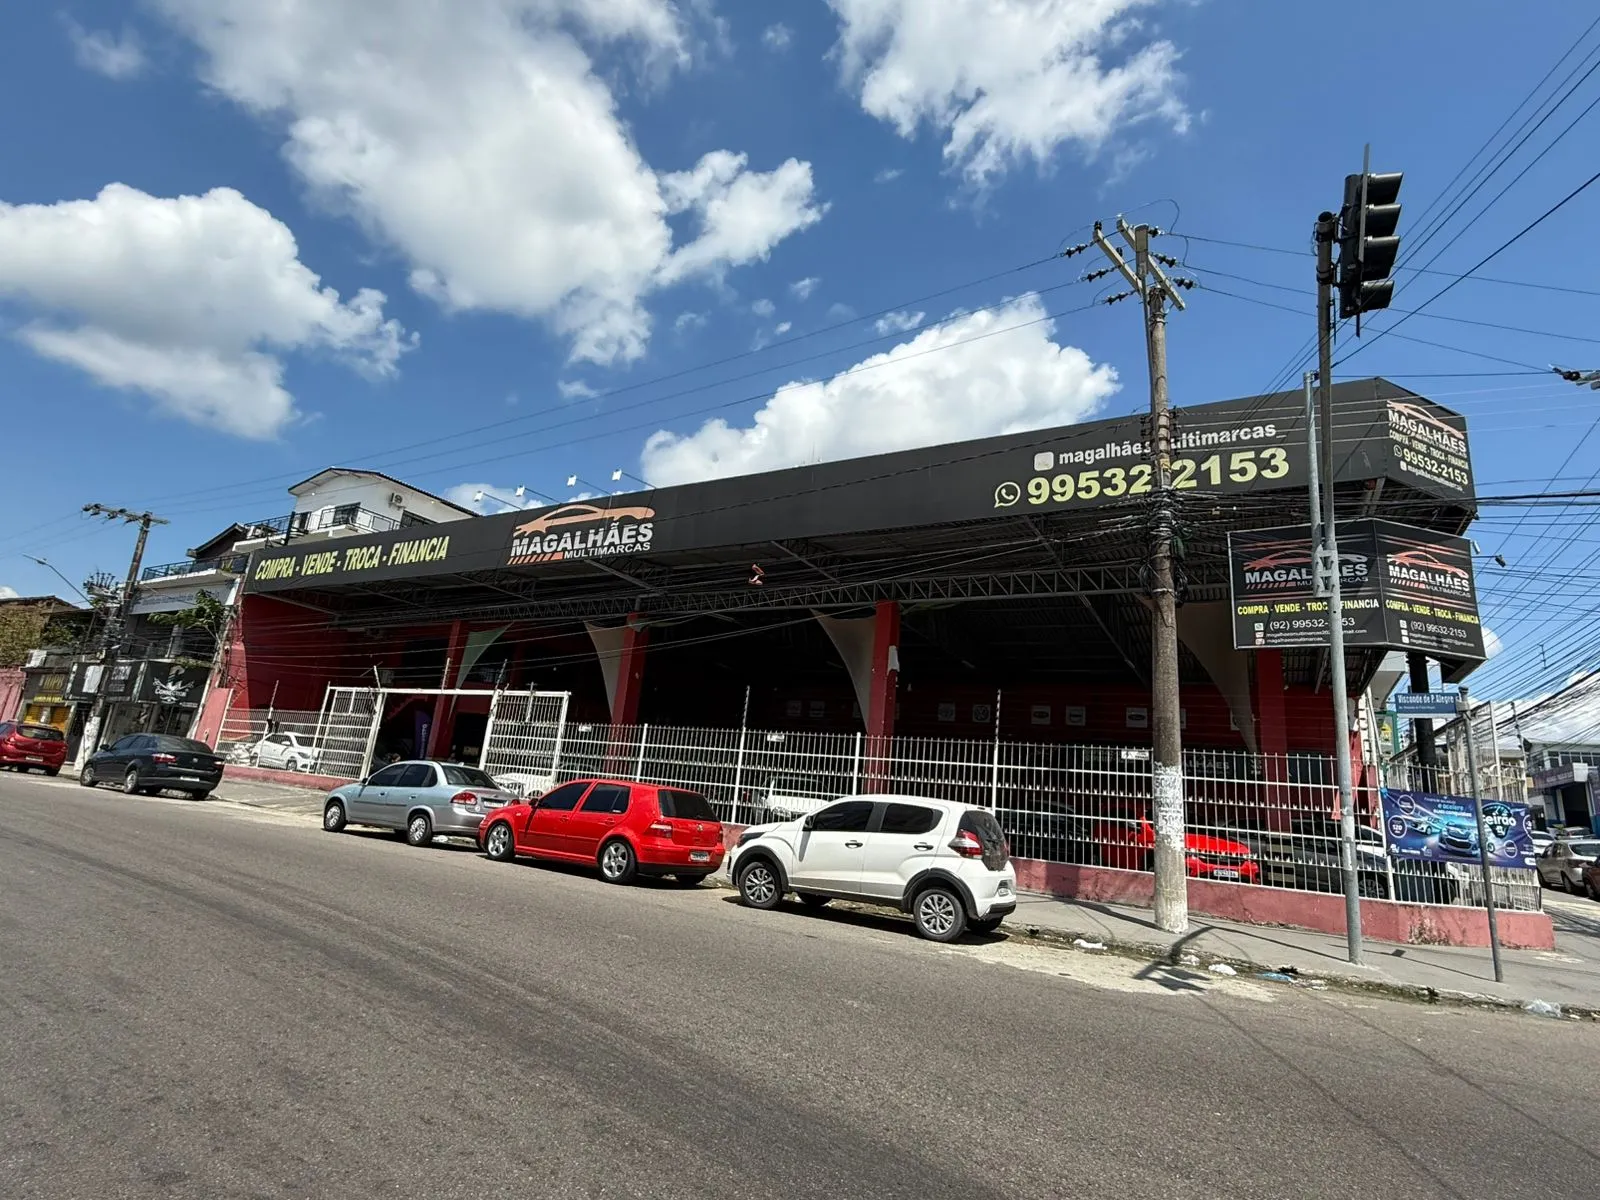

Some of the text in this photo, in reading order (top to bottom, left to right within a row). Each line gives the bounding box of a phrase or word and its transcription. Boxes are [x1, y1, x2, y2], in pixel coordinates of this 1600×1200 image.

[1059, 423, 1287, 465] magalhãesultimarcas_
[1389, 429, 1409, 445] COMPRA
[1412, 439, 1427, 454] VENDE
[1430, 447, 1446, 460] TROCA
[1447, 454, 1469, 471] FINANCIA
[1028, 447, 1290, 505] 995322153
[1403, 448, 1469, 485] 99532-2153
[510, 522, 653, 557] MAGALHÃES
[563, 541, 651, 560] MULTIMARCAS
[255, 557, 296, 580] COMPRA
[301, 551, 339, 576] VENDE
[342, 545, 382, 572] TROCA
[387, 536, 450, 566] FINANCIA
[1245, 563, 1369, 584] MAGALES
[1297, 576, 1369, 587] MURCAS
[1388, 565, 1470, 592] MAGALHÃES
[1425, 584, 1471, 598] MULTIMARCAS
[1237, 603, 1269, 615] COMPRA
[1274, 602, 1301, 613] VENDE
[1306, 601, 1328, 612] TROC
[1340, 599, 1380, 610] FINANCIA
[1385, 599, 1409, 612] COMPRA
[1412, 604, 1431, 616] VENDE
[1434, 607, 1452, 619] TROCA
[1455, 612, 1480, 624] FINANCIA
[1269, 617, 1356, 631] (92) 99532-53
[1410, 620, 1467, 638] (92) 99532-2153
[1398, 694, 1423, 704] Visconde
[1423, 694, 1431, 704] de
